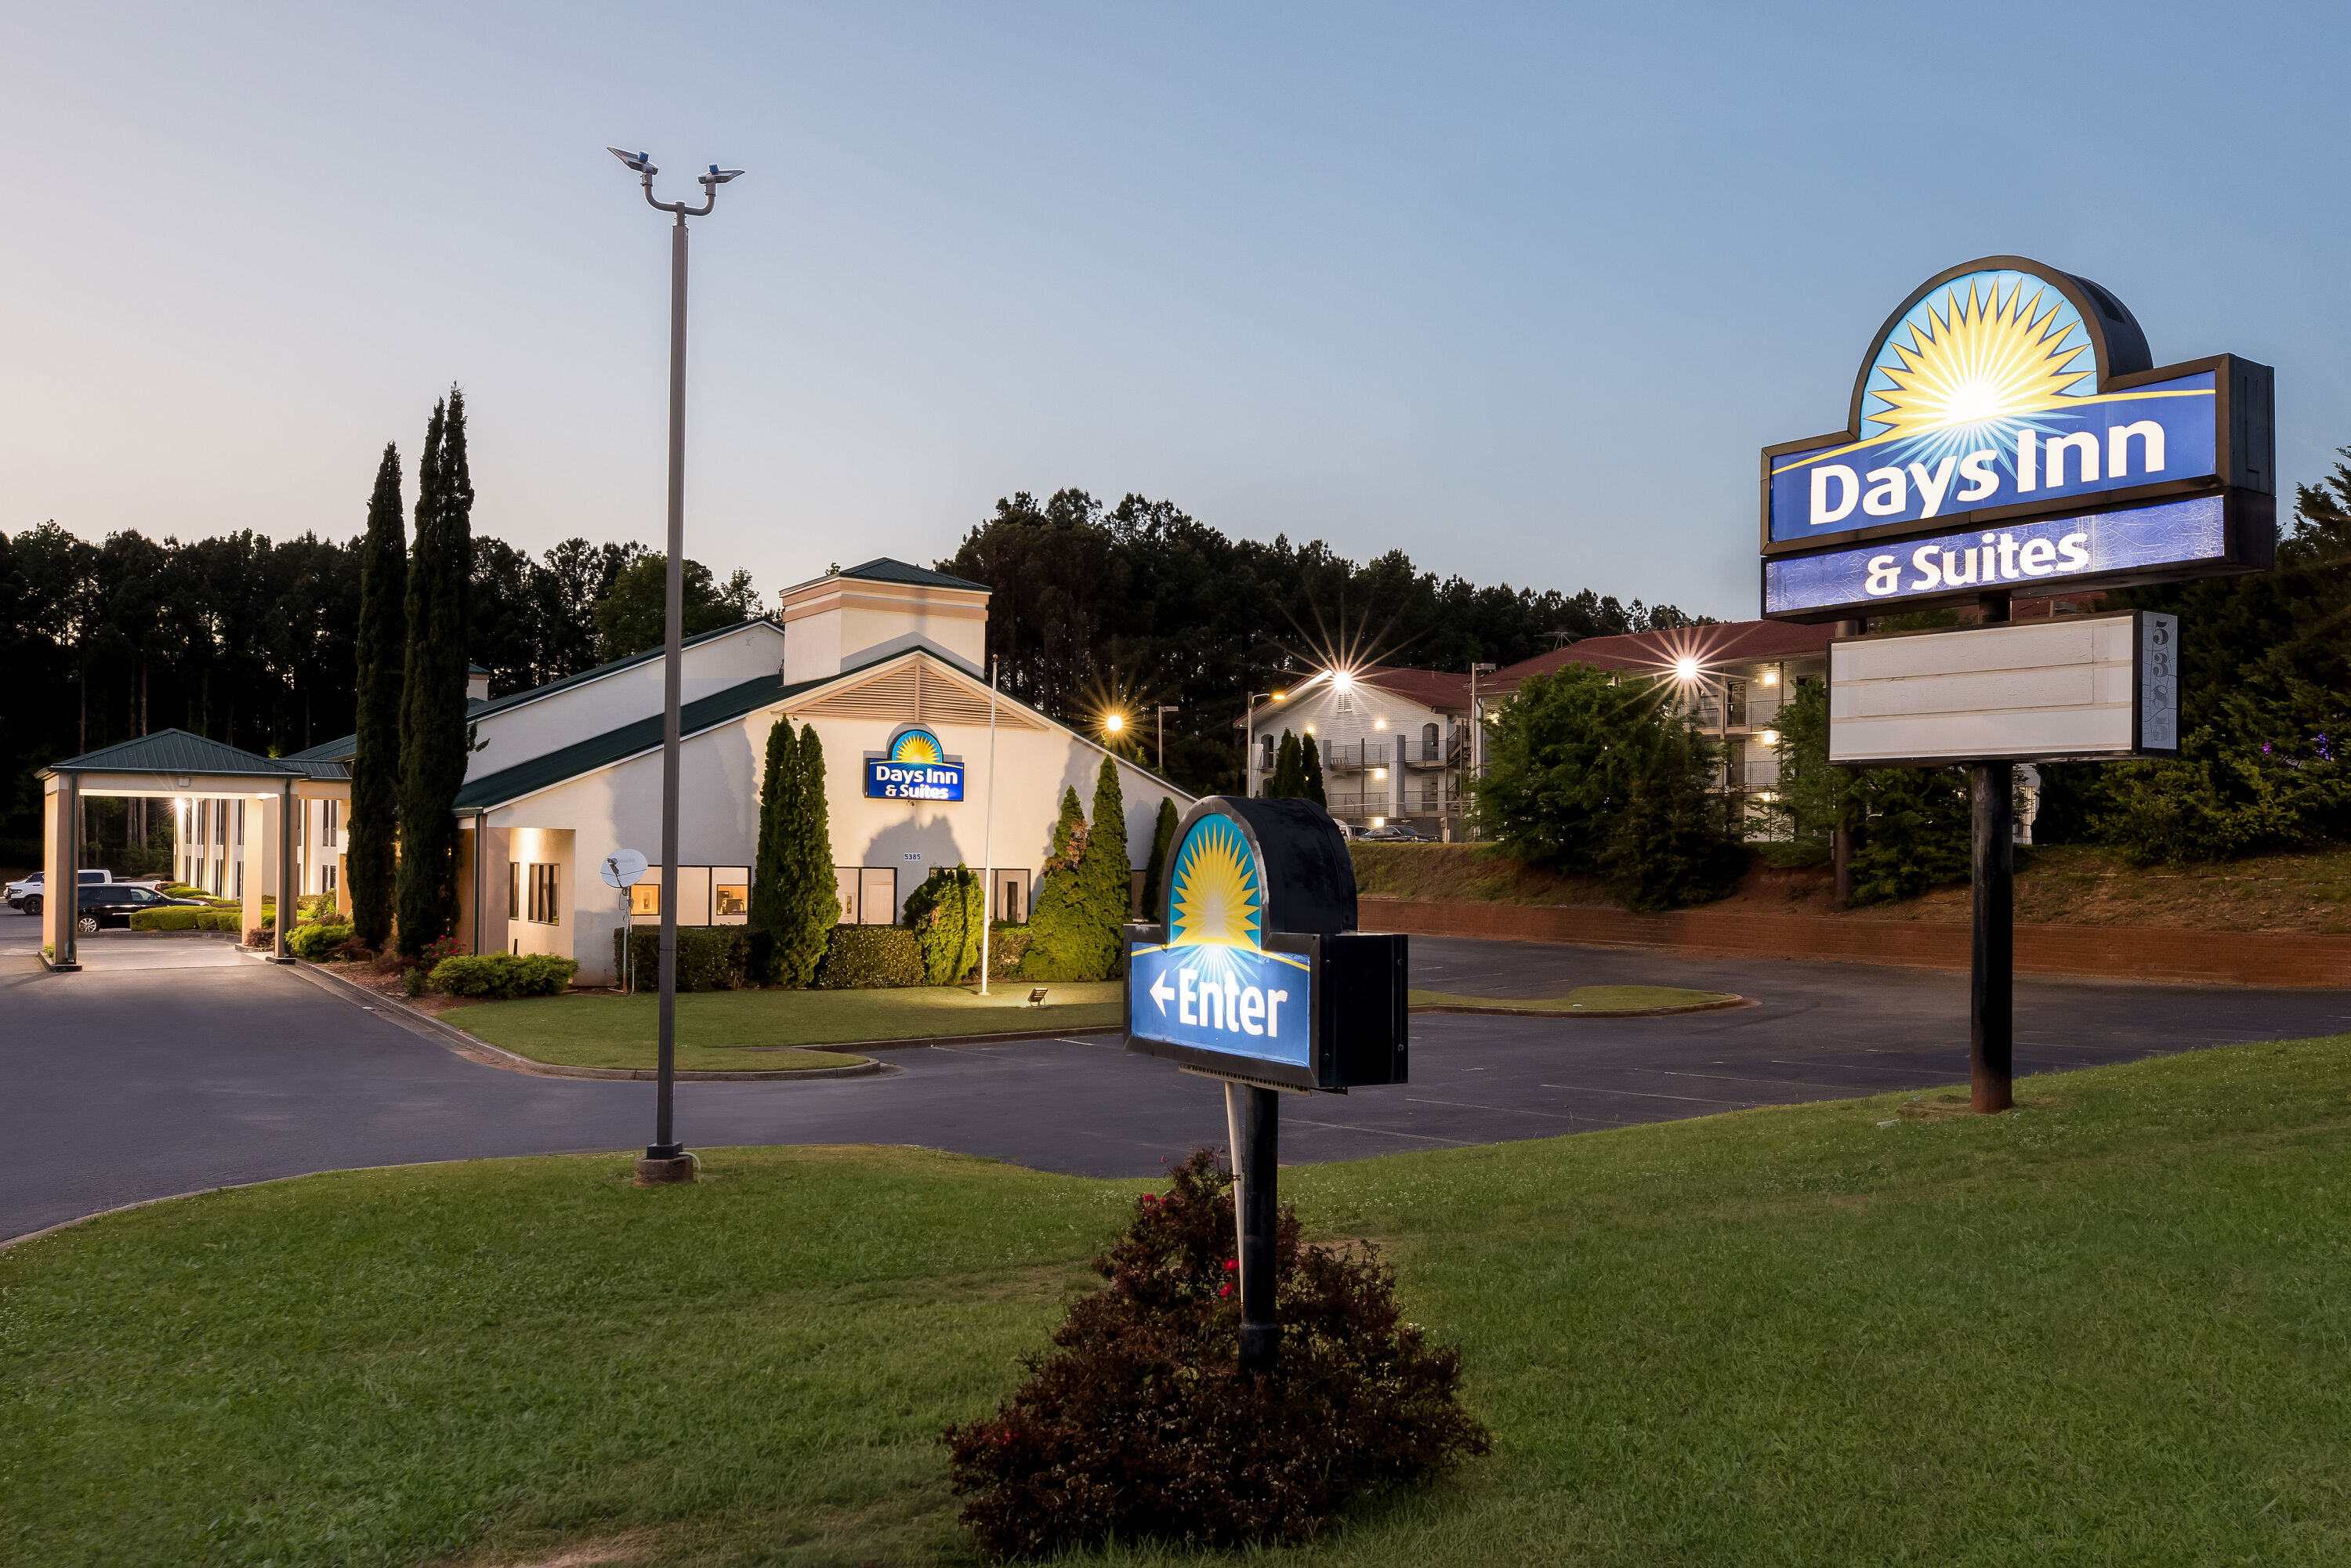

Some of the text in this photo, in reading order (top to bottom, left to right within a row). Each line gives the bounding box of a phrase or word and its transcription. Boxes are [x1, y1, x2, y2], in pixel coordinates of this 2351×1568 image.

[1809, 420, 2165, 525] Days Inn
[1864, 532, 2090, 596] & Suites
[876, 766, 958, 784] Days Inn
[885, 784, 948, 799] & Suites
[1179, 968, 1288, 1037] Enter
